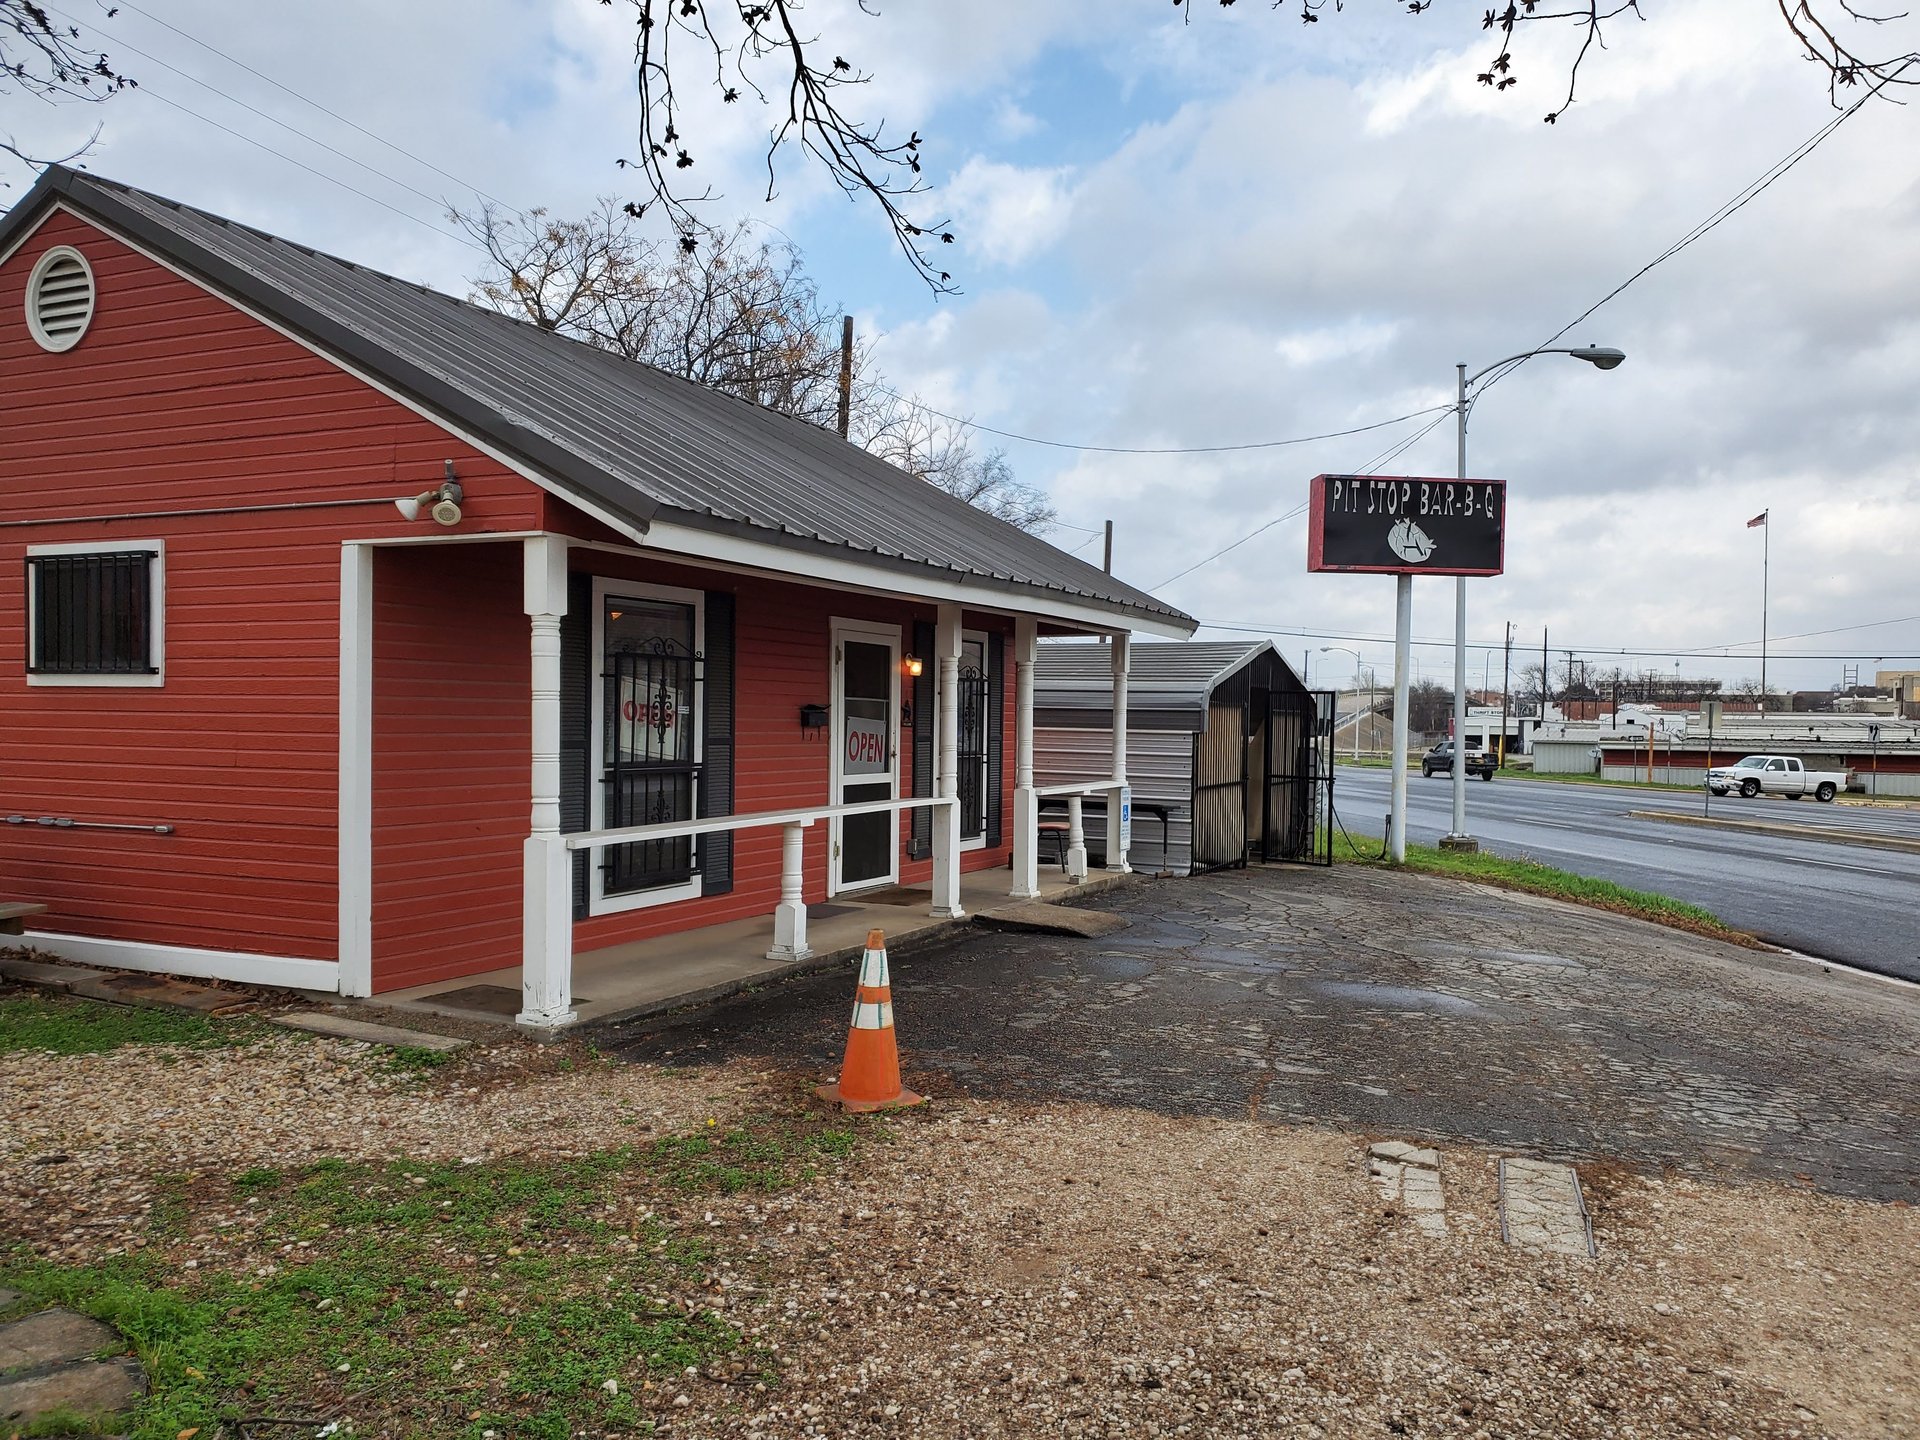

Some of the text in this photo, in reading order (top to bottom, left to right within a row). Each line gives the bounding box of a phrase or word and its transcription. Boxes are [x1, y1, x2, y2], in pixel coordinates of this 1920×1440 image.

[1332, 480, 1494, 519] PIT STOP BAR-B-Q
[848, 730, 884, 763] OPEN
